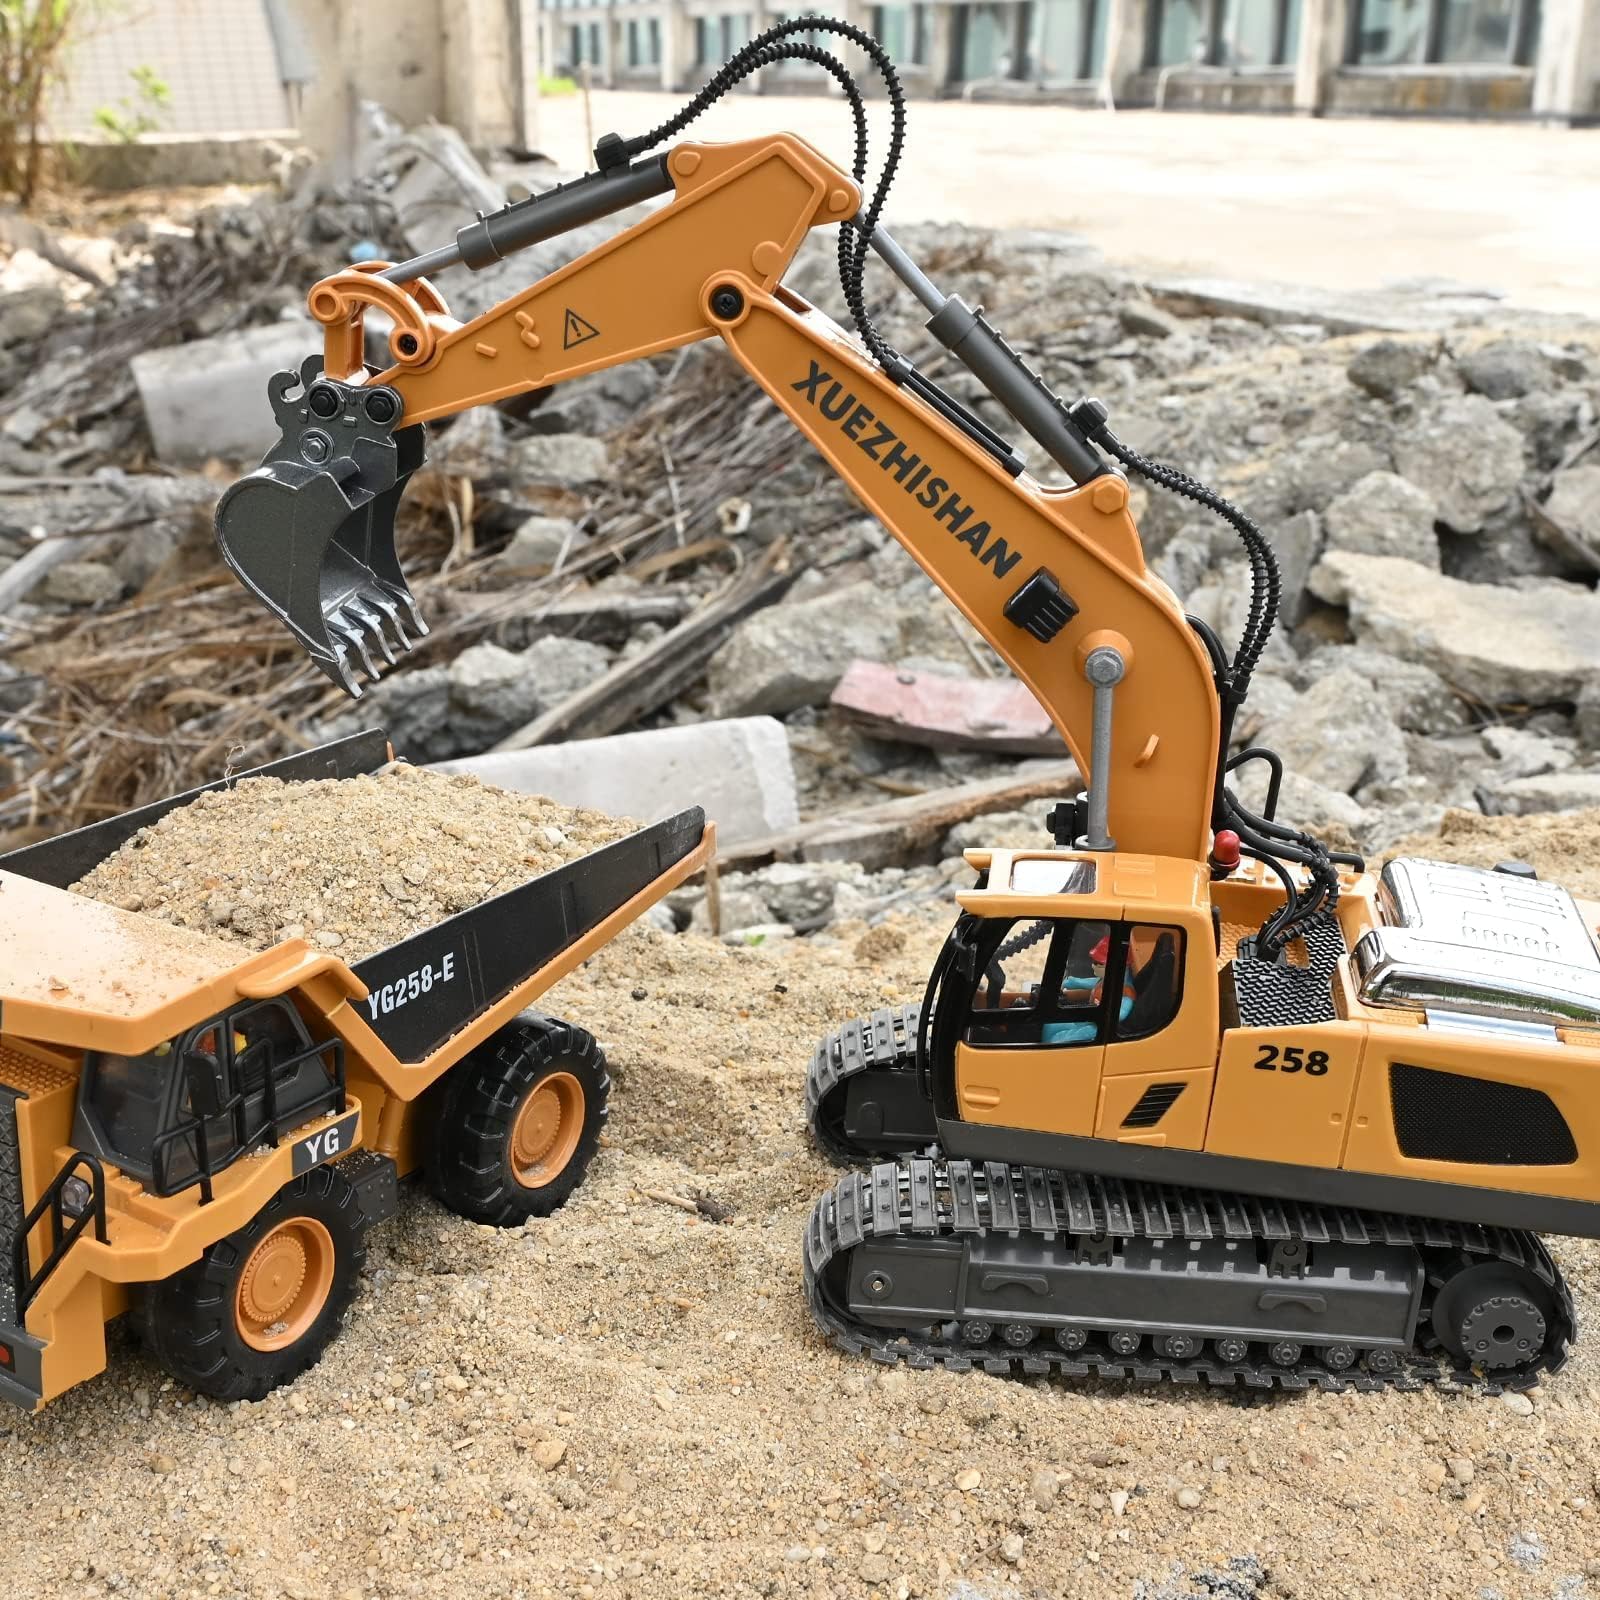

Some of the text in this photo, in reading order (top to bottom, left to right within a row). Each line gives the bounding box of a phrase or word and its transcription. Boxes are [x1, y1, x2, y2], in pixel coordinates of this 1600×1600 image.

[790, 359, 1023, 580] XUEZHISHAN
[367, 952, 455, 1021] YG258-E
[1254, 1045, 1329, 1076] 258
[305, 1128, 339, 1164] YG
